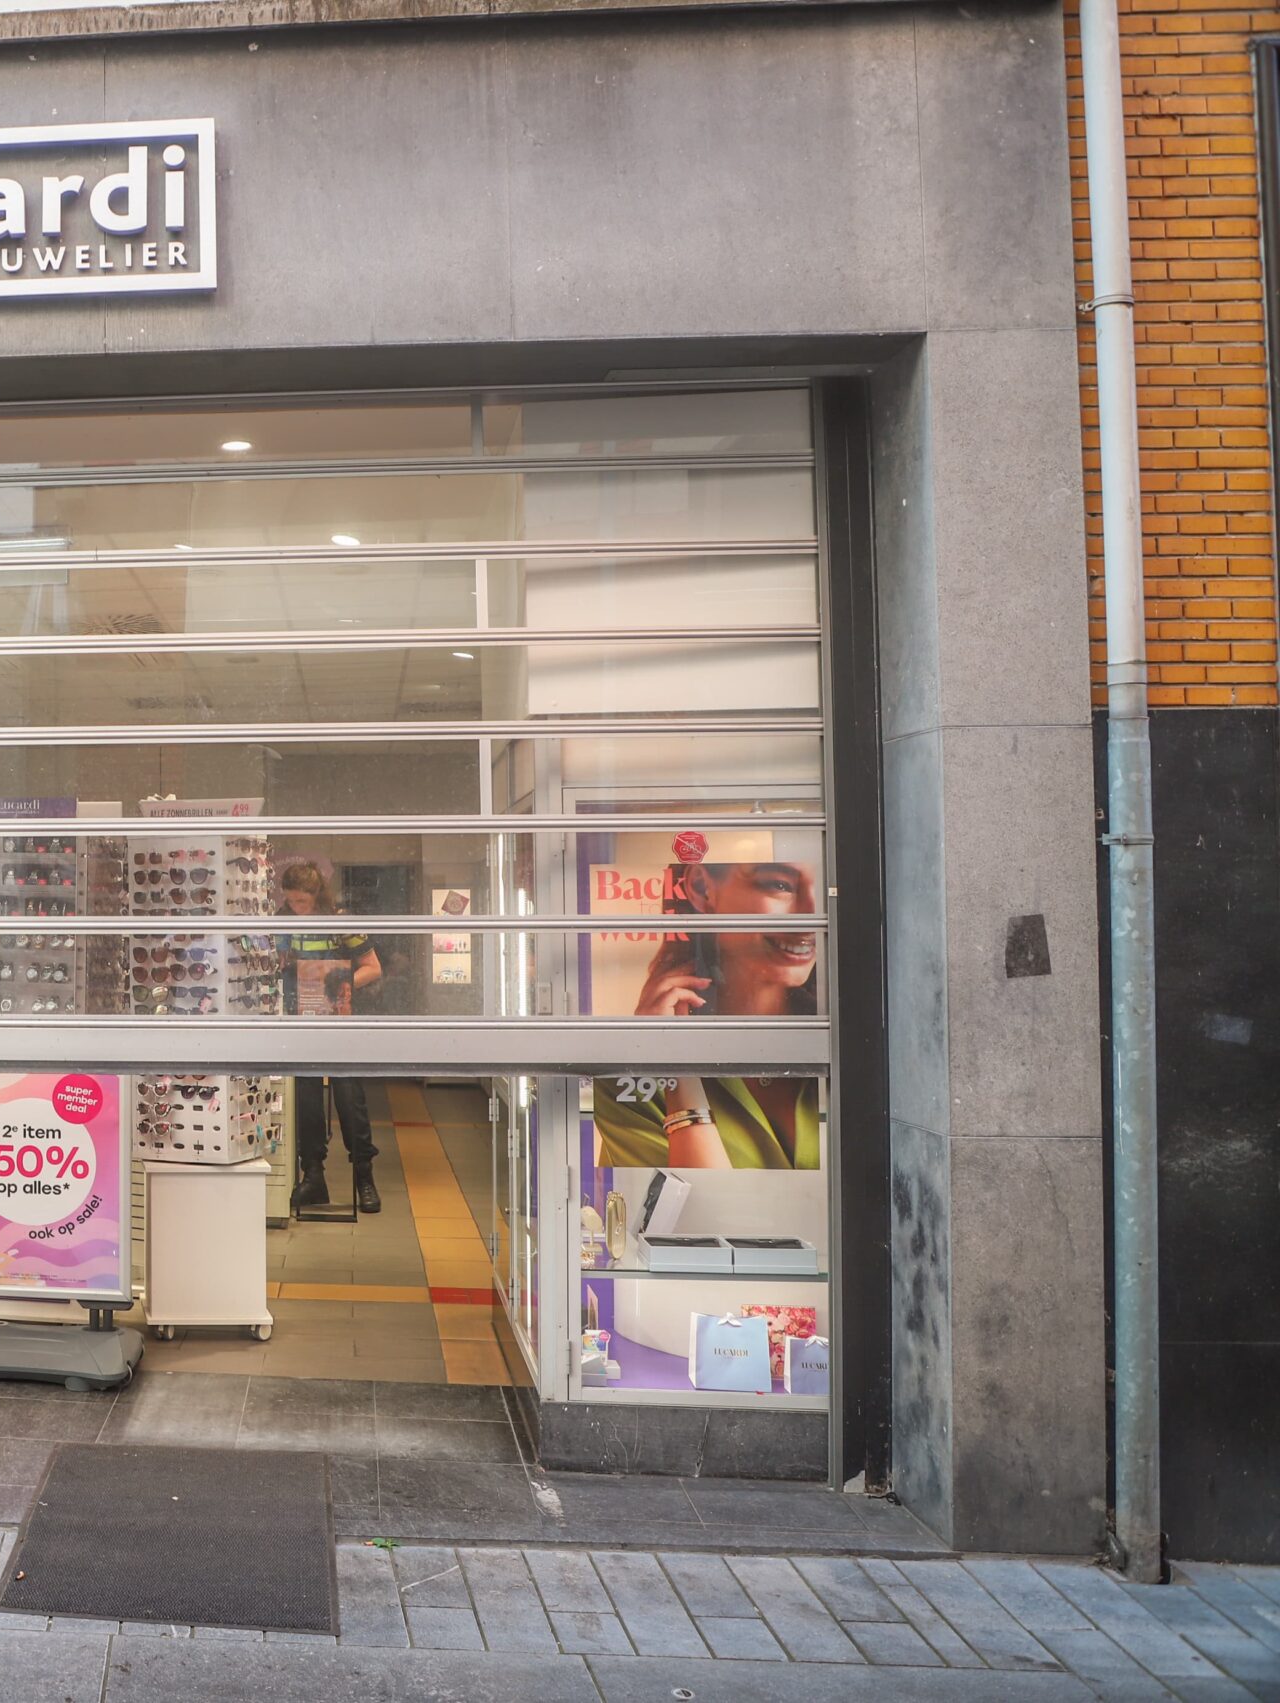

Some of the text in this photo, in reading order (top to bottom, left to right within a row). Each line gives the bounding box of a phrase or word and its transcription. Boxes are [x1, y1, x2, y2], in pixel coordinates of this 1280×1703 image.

[596, 868, 687, 900] Back
[65, 1085, 93, 1097] super
[57, 1092, 99, 1107] member
[65, 1102, 88, 1114] deal
[22, 1124, 62, 1140] item
[28, 1194, 104, 1241] ook op sale!
